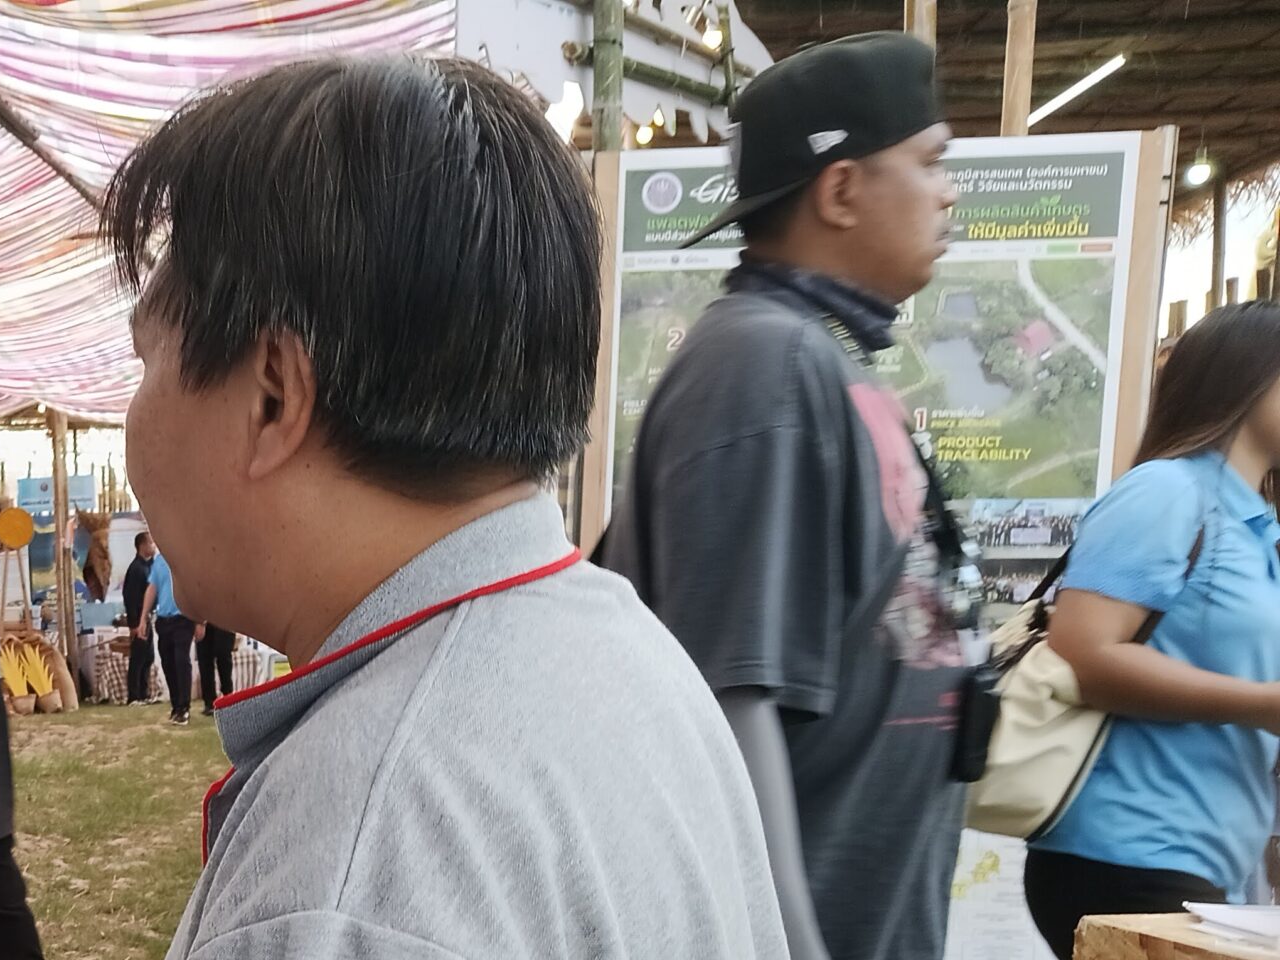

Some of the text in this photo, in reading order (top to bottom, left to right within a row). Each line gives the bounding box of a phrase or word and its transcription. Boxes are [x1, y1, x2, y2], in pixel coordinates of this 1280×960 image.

[1026, 164, 1108, 179] (องค์การมหาชน)
[977, 178, 1073, 194] วิจัยและนวัตกรรม
[968, 215, 1090, 241] ให้มีมูลค่าเพิ่มขึ้น
[938, 435, 1003, 448] PRODUCT
[937, 447, 1032, 461] TRACEABILITY
